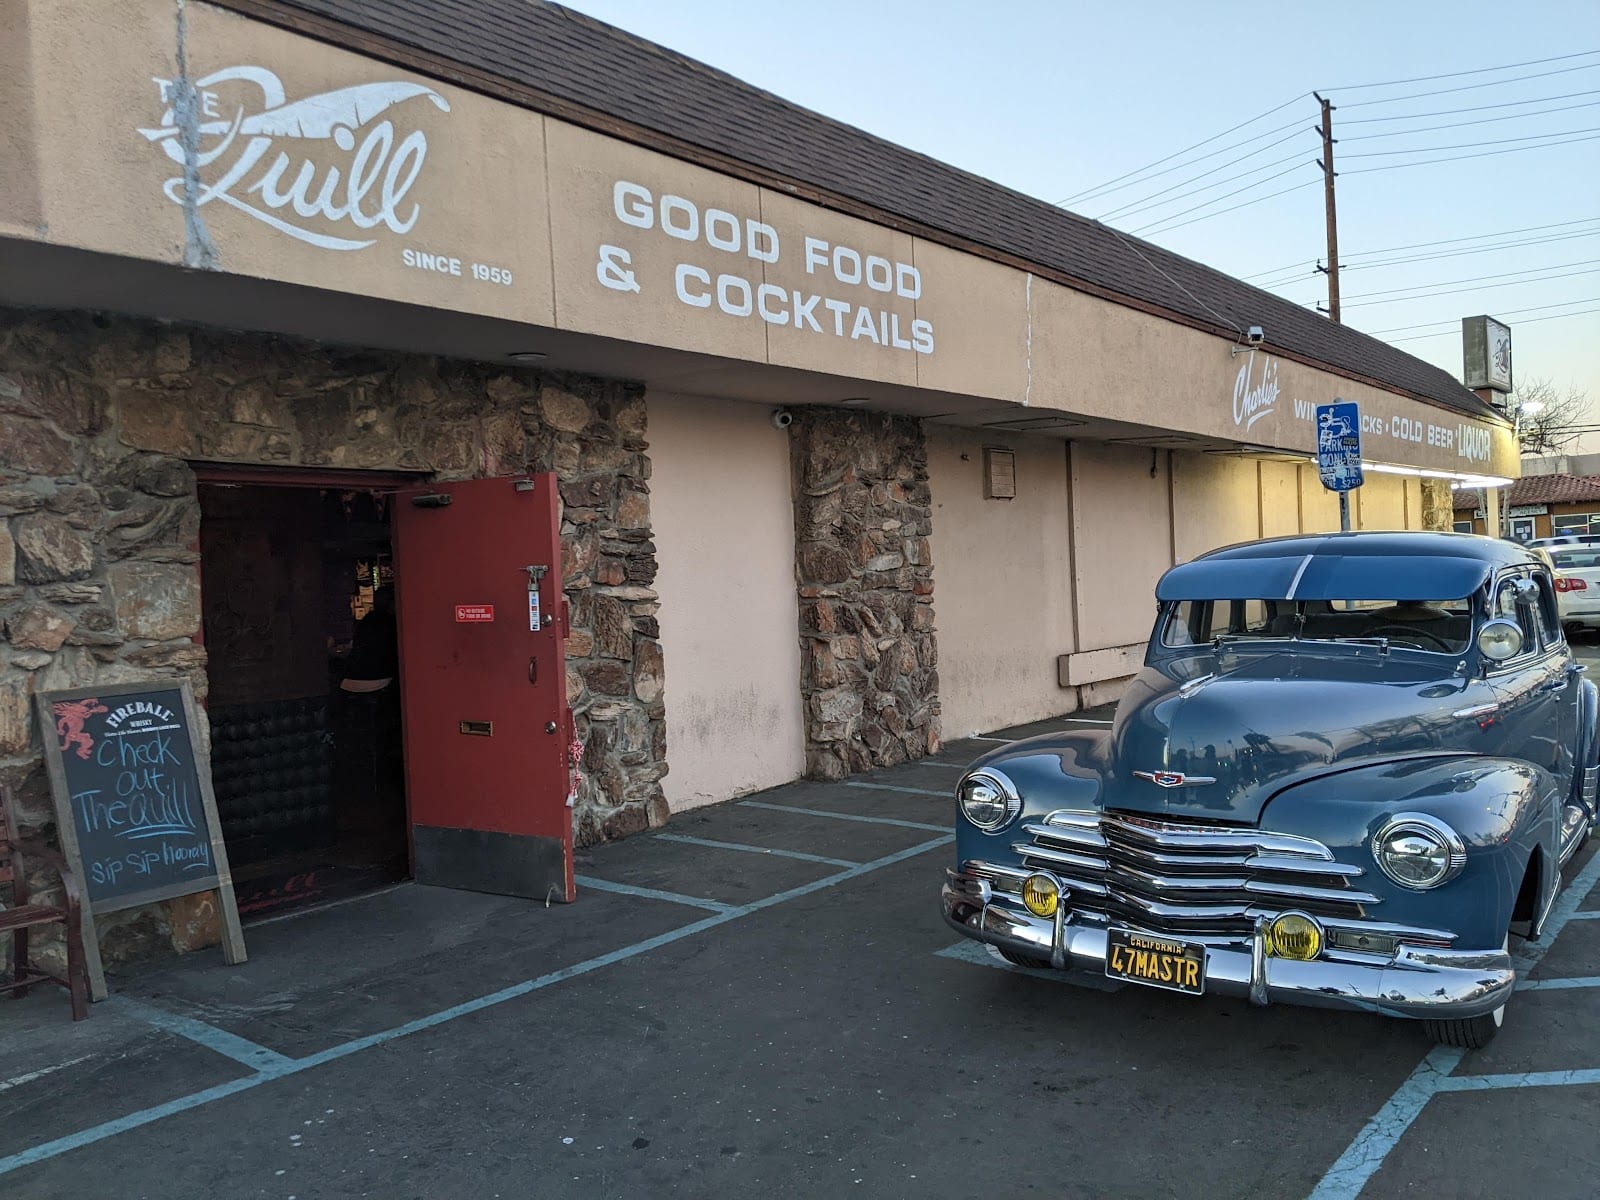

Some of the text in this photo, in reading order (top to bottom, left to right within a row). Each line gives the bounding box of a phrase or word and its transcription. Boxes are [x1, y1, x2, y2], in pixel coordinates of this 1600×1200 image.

[152, 77, 220, 118] TE
[142, 66, 440, 250] Quill
[613, 180, 921, 300] GOOD FOOD
[402, 248, 513, 286] SINCE 1959
[596, 244, 934, 354] & COCKTAILS
[1233, 350, 1281, 426] Charlie's
[1391, 415, 1423, 443] COLD
[1427, 424, 1453, 449] BEER
[1458, 423, 1491, 463] LIQUOR
[105, 701, 174, 728] FIREBALL
[72, 778, 196, 833] The Quill
[1111, 945, 1199, 987] 47MASTR
[1130, 935, 1183, 955] CALIFORNIA
